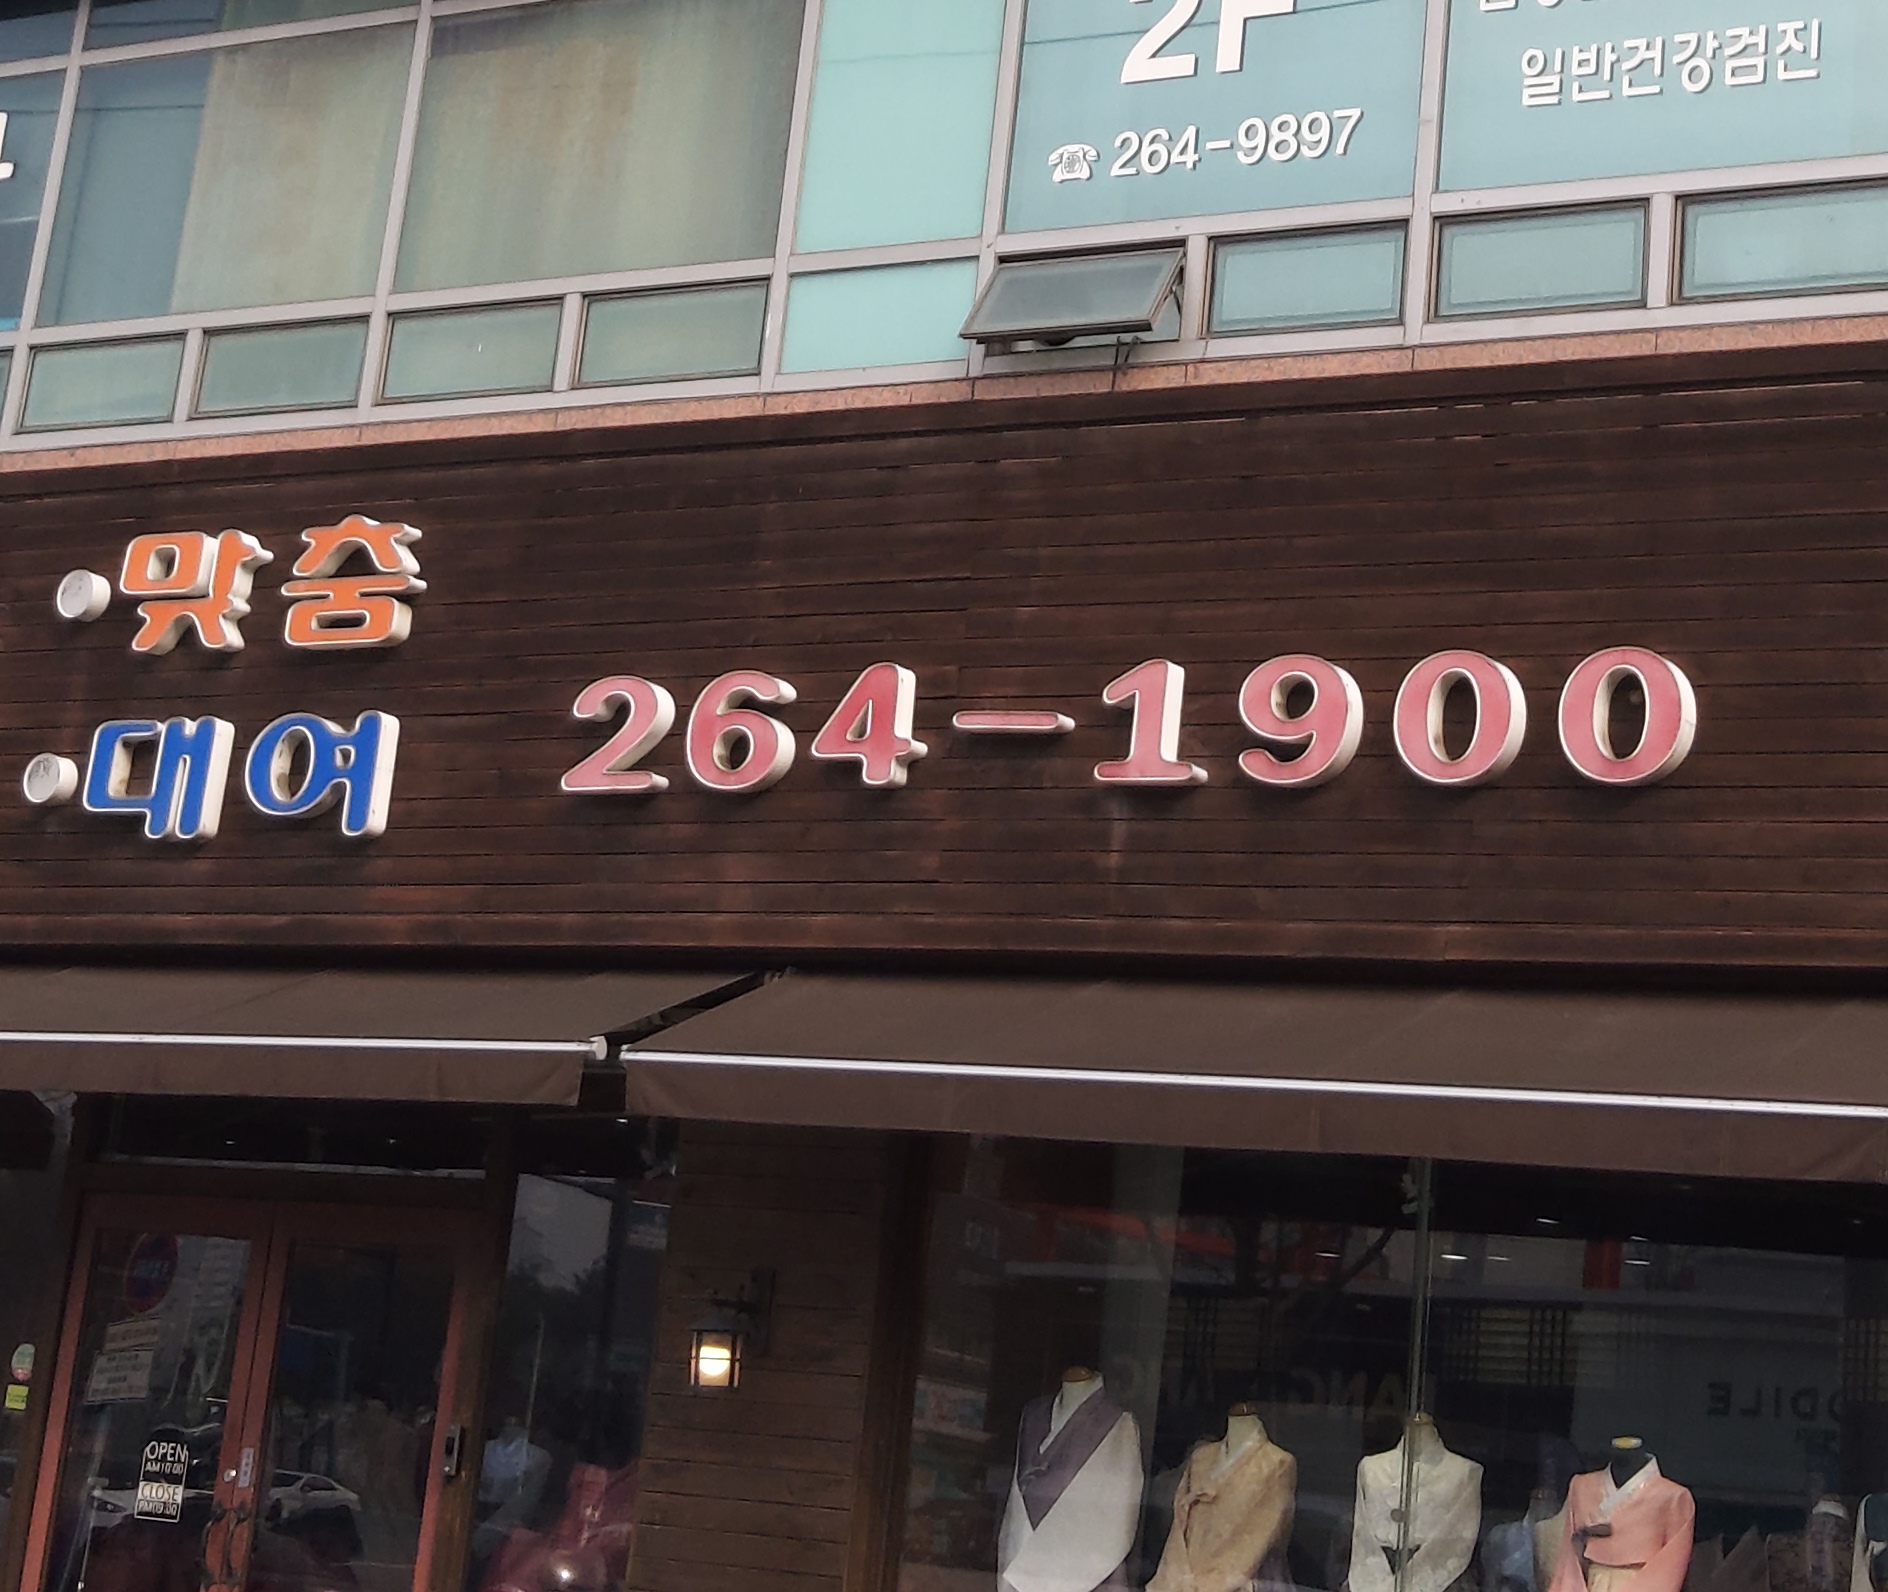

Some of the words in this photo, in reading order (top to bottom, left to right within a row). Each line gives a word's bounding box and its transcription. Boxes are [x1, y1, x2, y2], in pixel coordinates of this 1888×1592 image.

[1521, 19, 1823, 108] 일반건강검진
[1109, 107, 1364, 179] 264-9897
[119, 513, 428, 657] 맞춤
[560, 644, 1696, 796] 264-1900
[82, 709, 401, 841] 대여
[141, 1483, 179, 1502] CLOSE
[146, 1440, 187, 1462] OPEN
